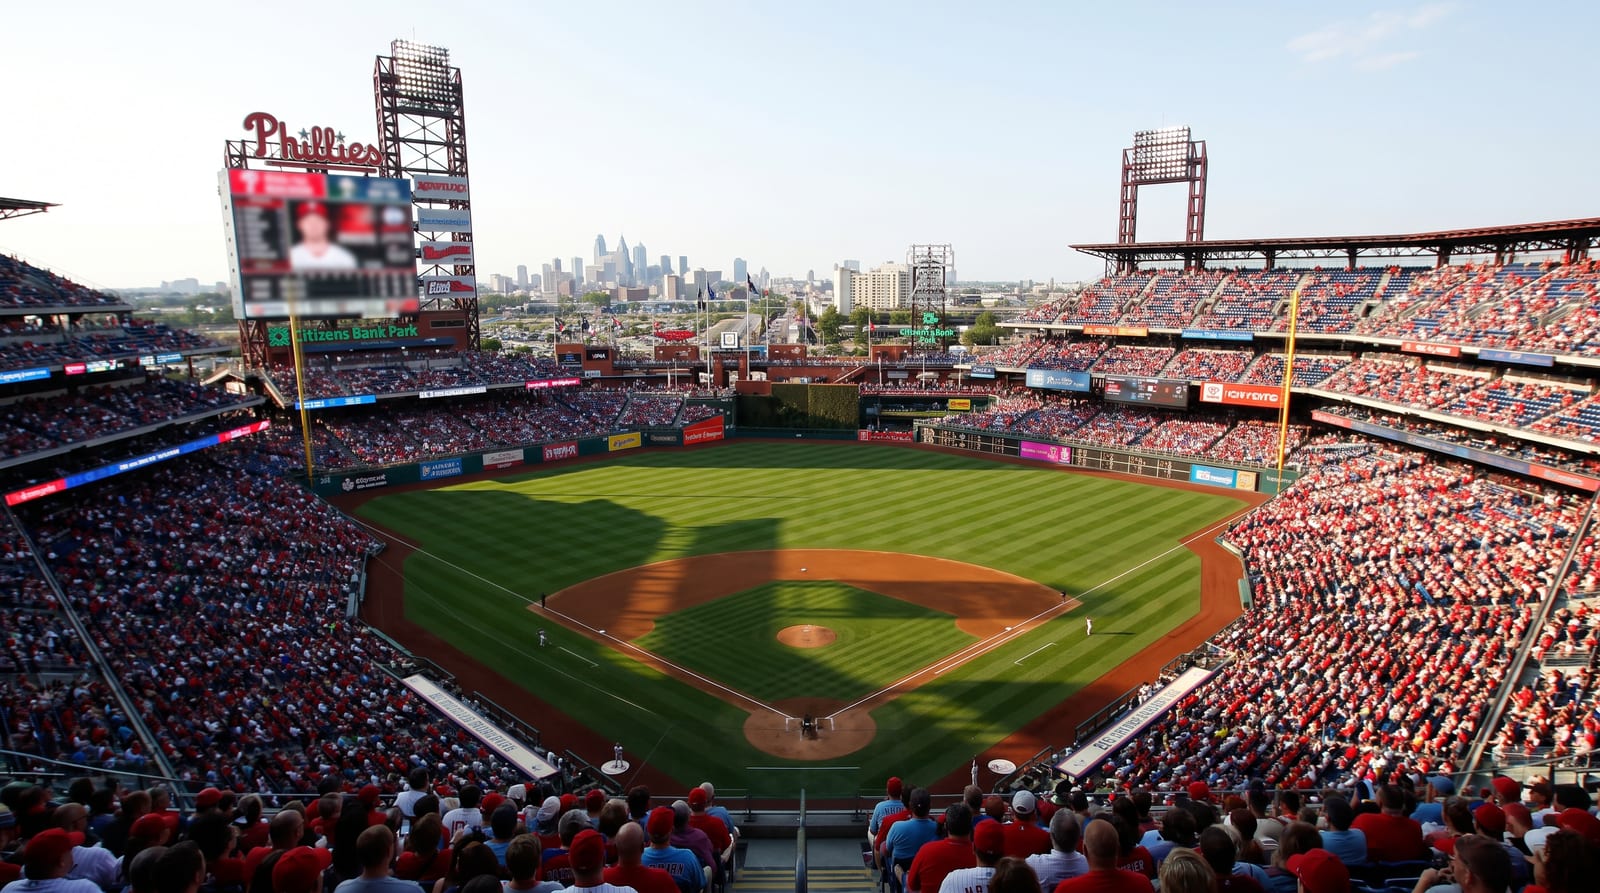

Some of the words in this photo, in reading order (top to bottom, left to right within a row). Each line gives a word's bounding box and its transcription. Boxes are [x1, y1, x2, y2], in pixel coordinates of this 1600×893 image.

[243, 111, 383, 166] Phillies
[352, 325, 386, 340] Bank
[388, 323, 418, 338] Park
